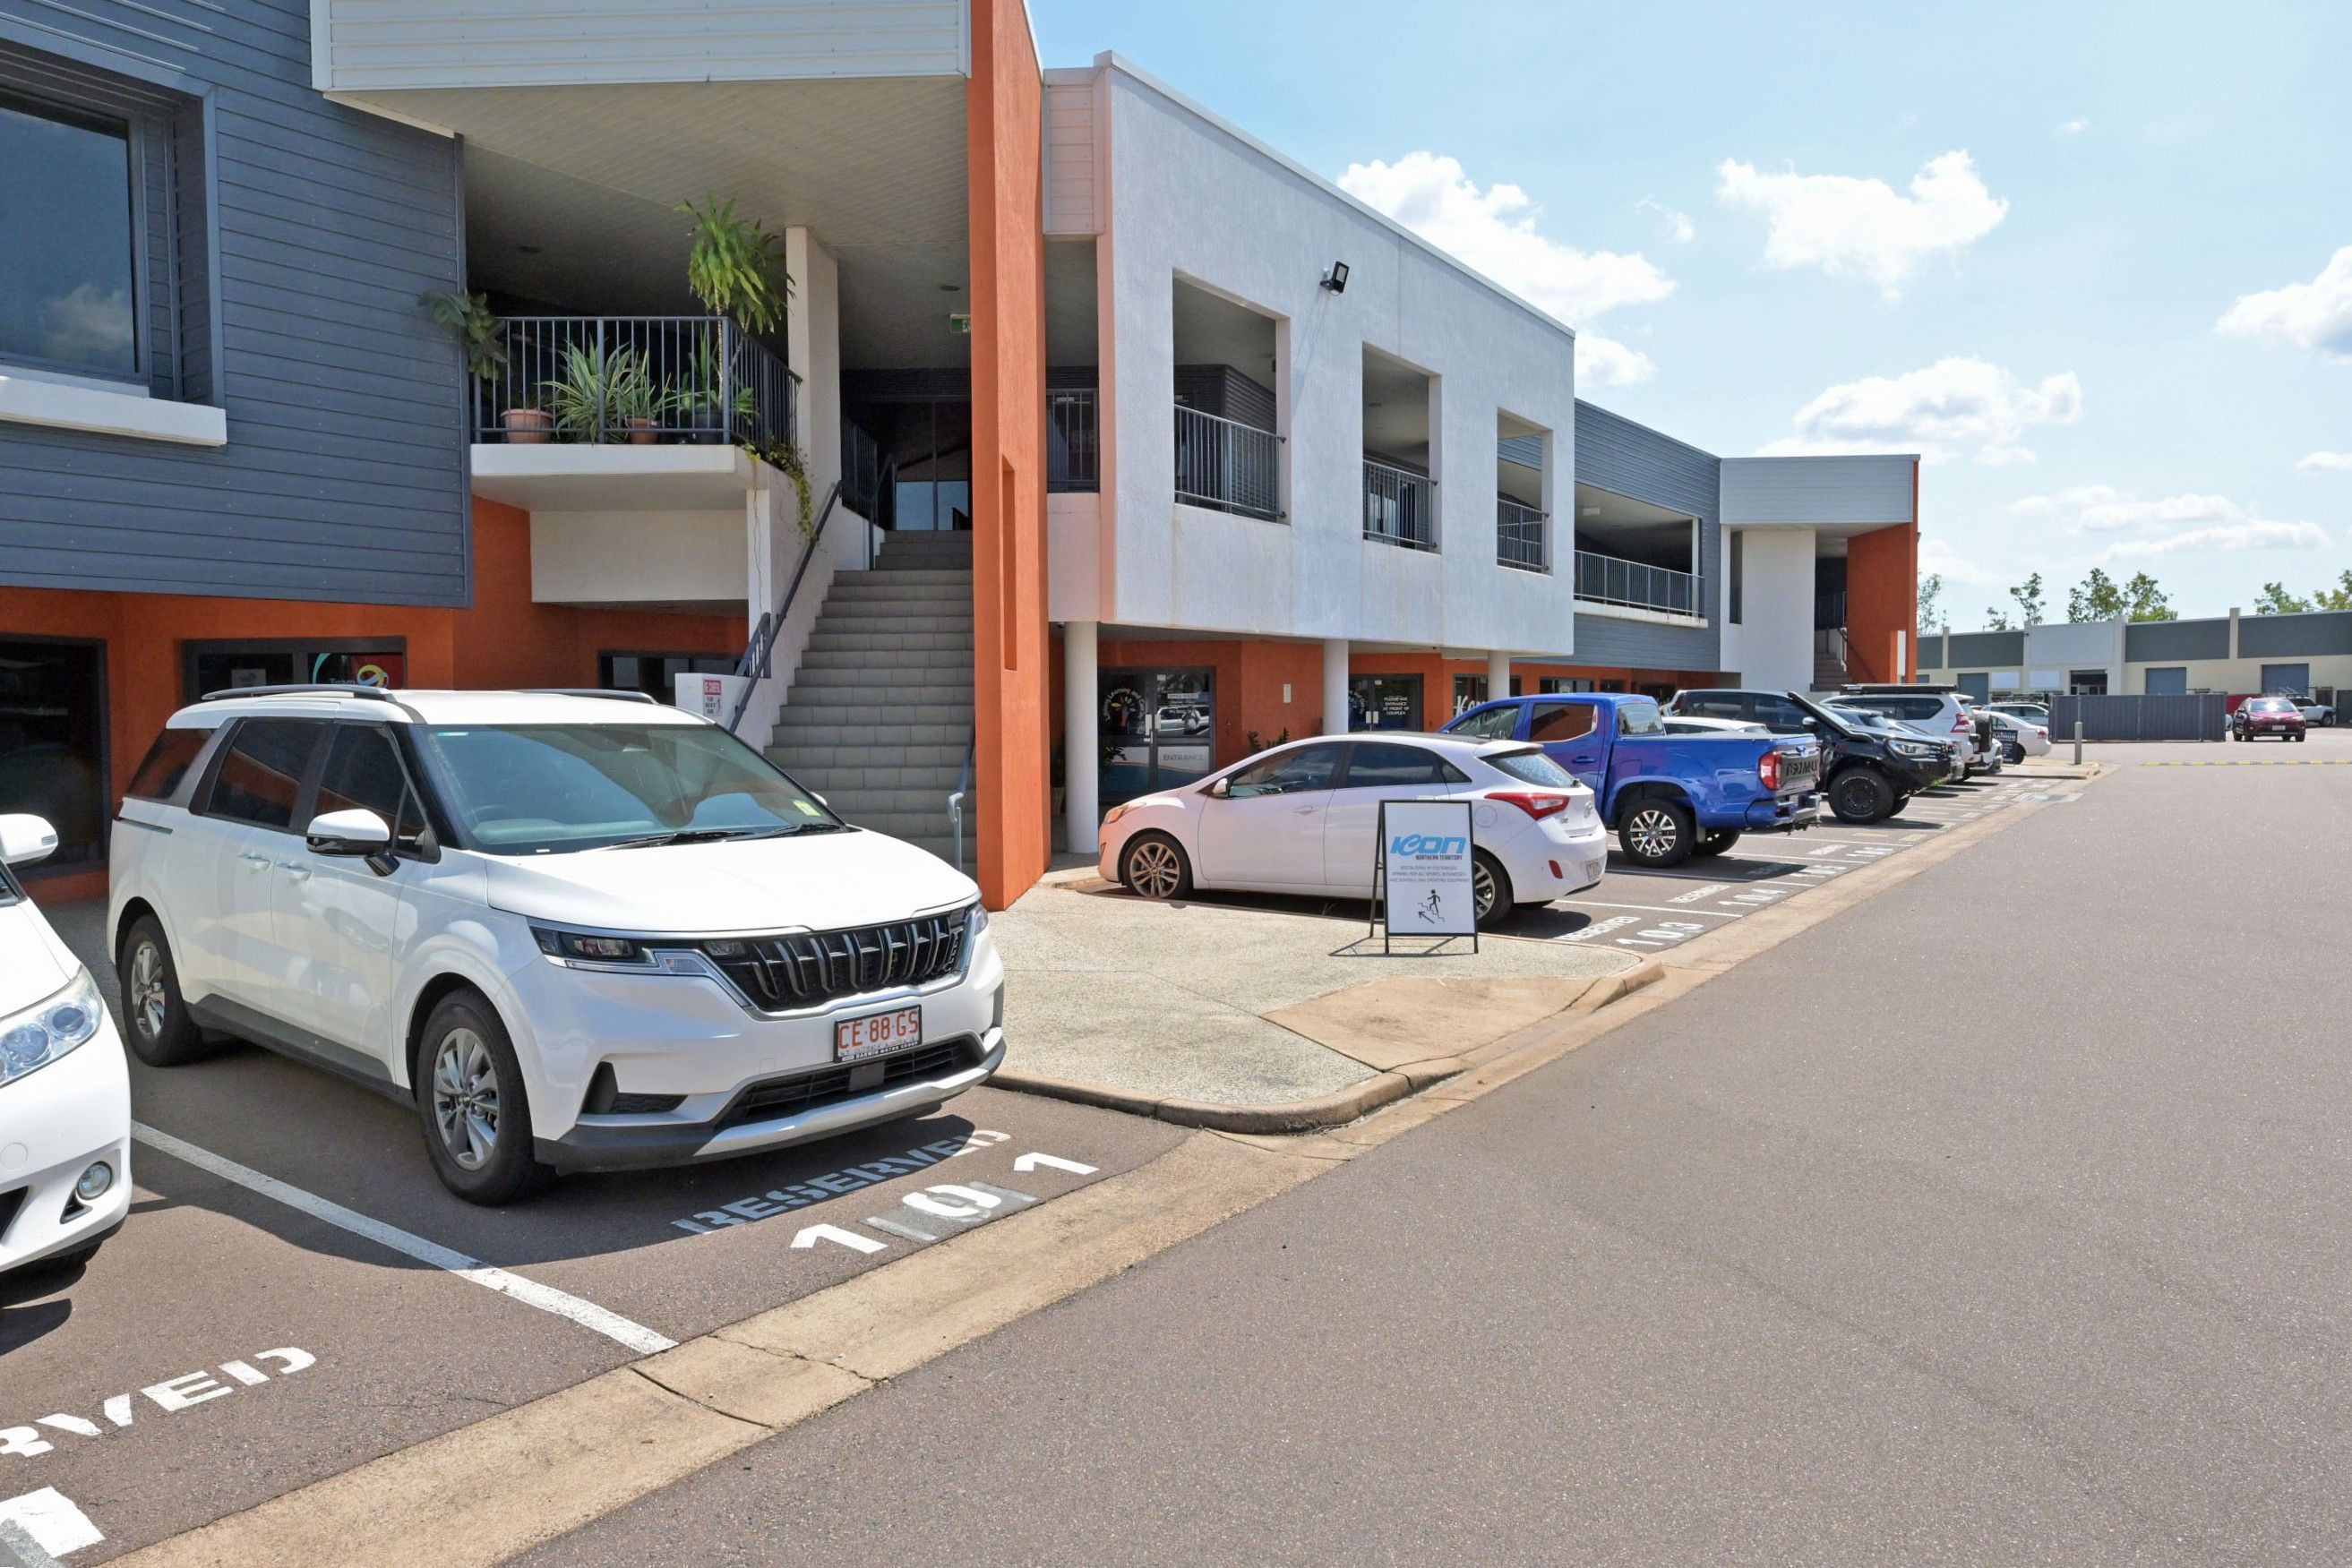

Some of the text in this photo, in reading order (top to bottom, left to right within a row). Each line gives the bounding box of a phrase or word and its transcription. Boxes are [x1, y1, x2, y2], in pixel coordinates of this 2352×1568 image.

[1615, 921, 1704, 946] 103
[855, 1050, 880, 1058] DARWIN
[670, 1129, 1011, 1235] RESERVED
